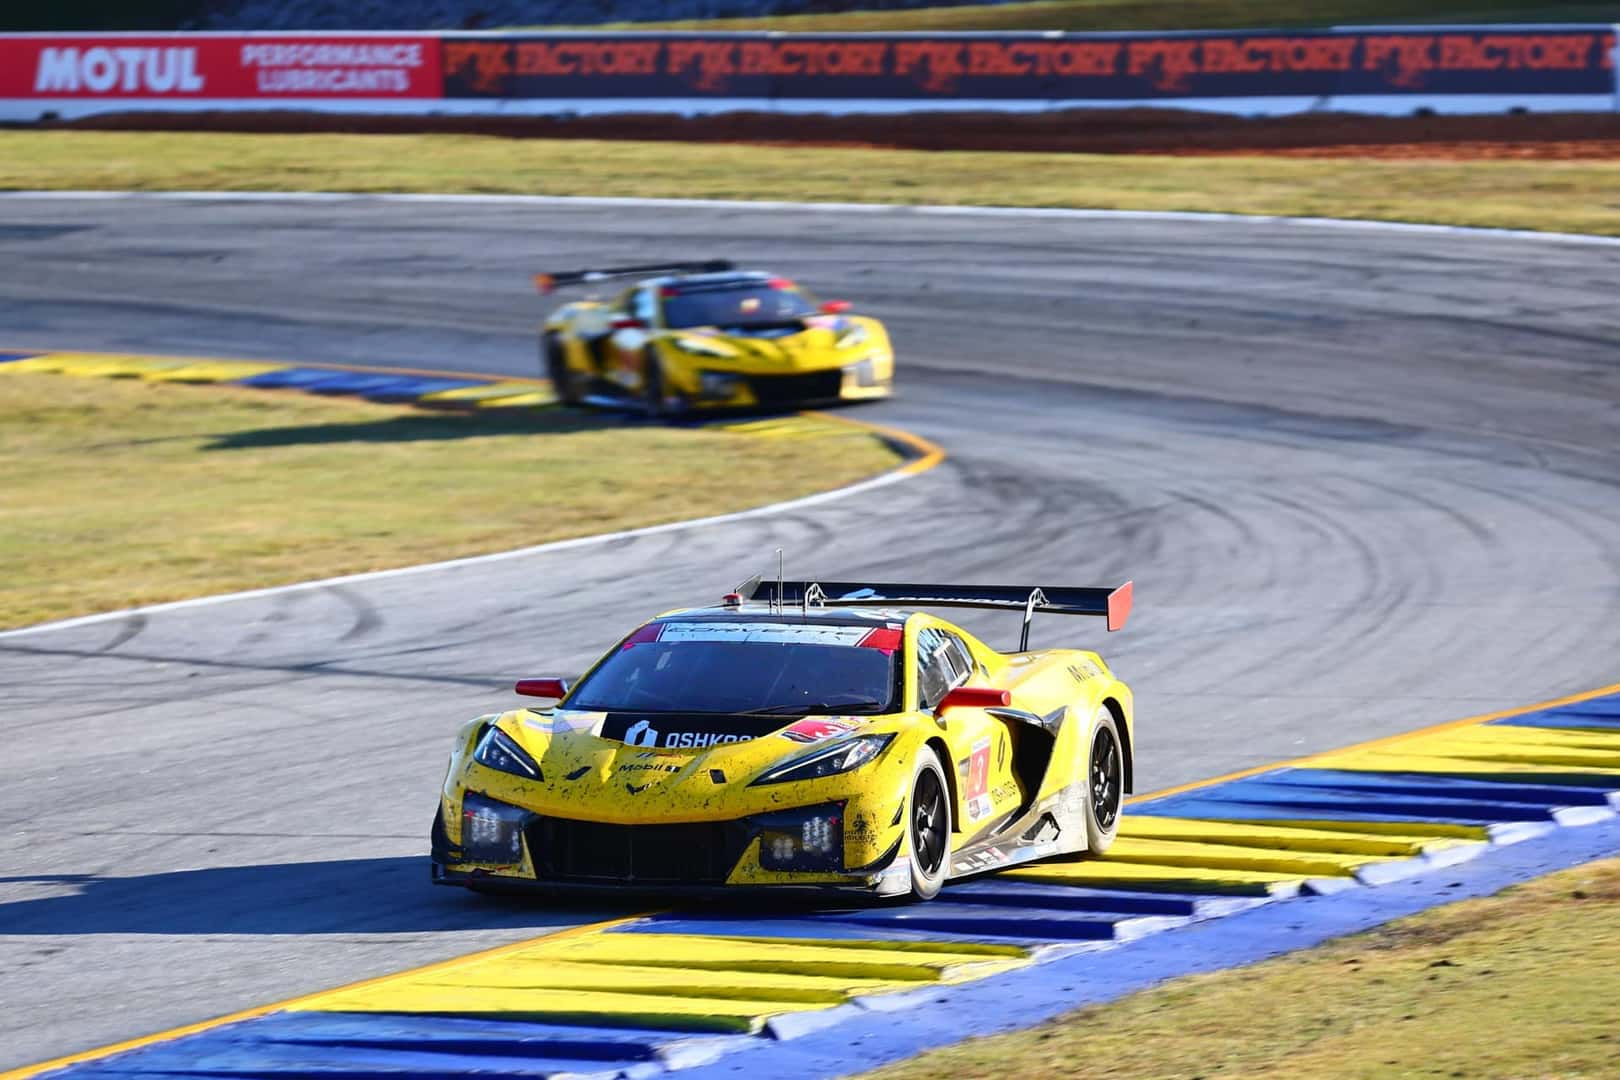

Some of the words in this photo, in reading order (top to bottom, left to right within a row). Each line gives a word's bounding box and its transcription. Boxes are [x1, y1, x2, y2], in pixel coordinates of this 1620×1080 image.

[240, 43, 423, 67] PERFORMANCE
[514, 42, 658, 75] FACTORY
[739, 42, 887, 75] FACTORY
[967, 42, 1121, 75] FACTORY
[1203, 38, 1357, 73] FACTORY
[1439, 36, 1595, 70] FACTORY
[34, 47, 205, 91] MOTUL
[256, 69, 411, 92] LUBRICANTS
[618, 764, 663, 773] Mobil
